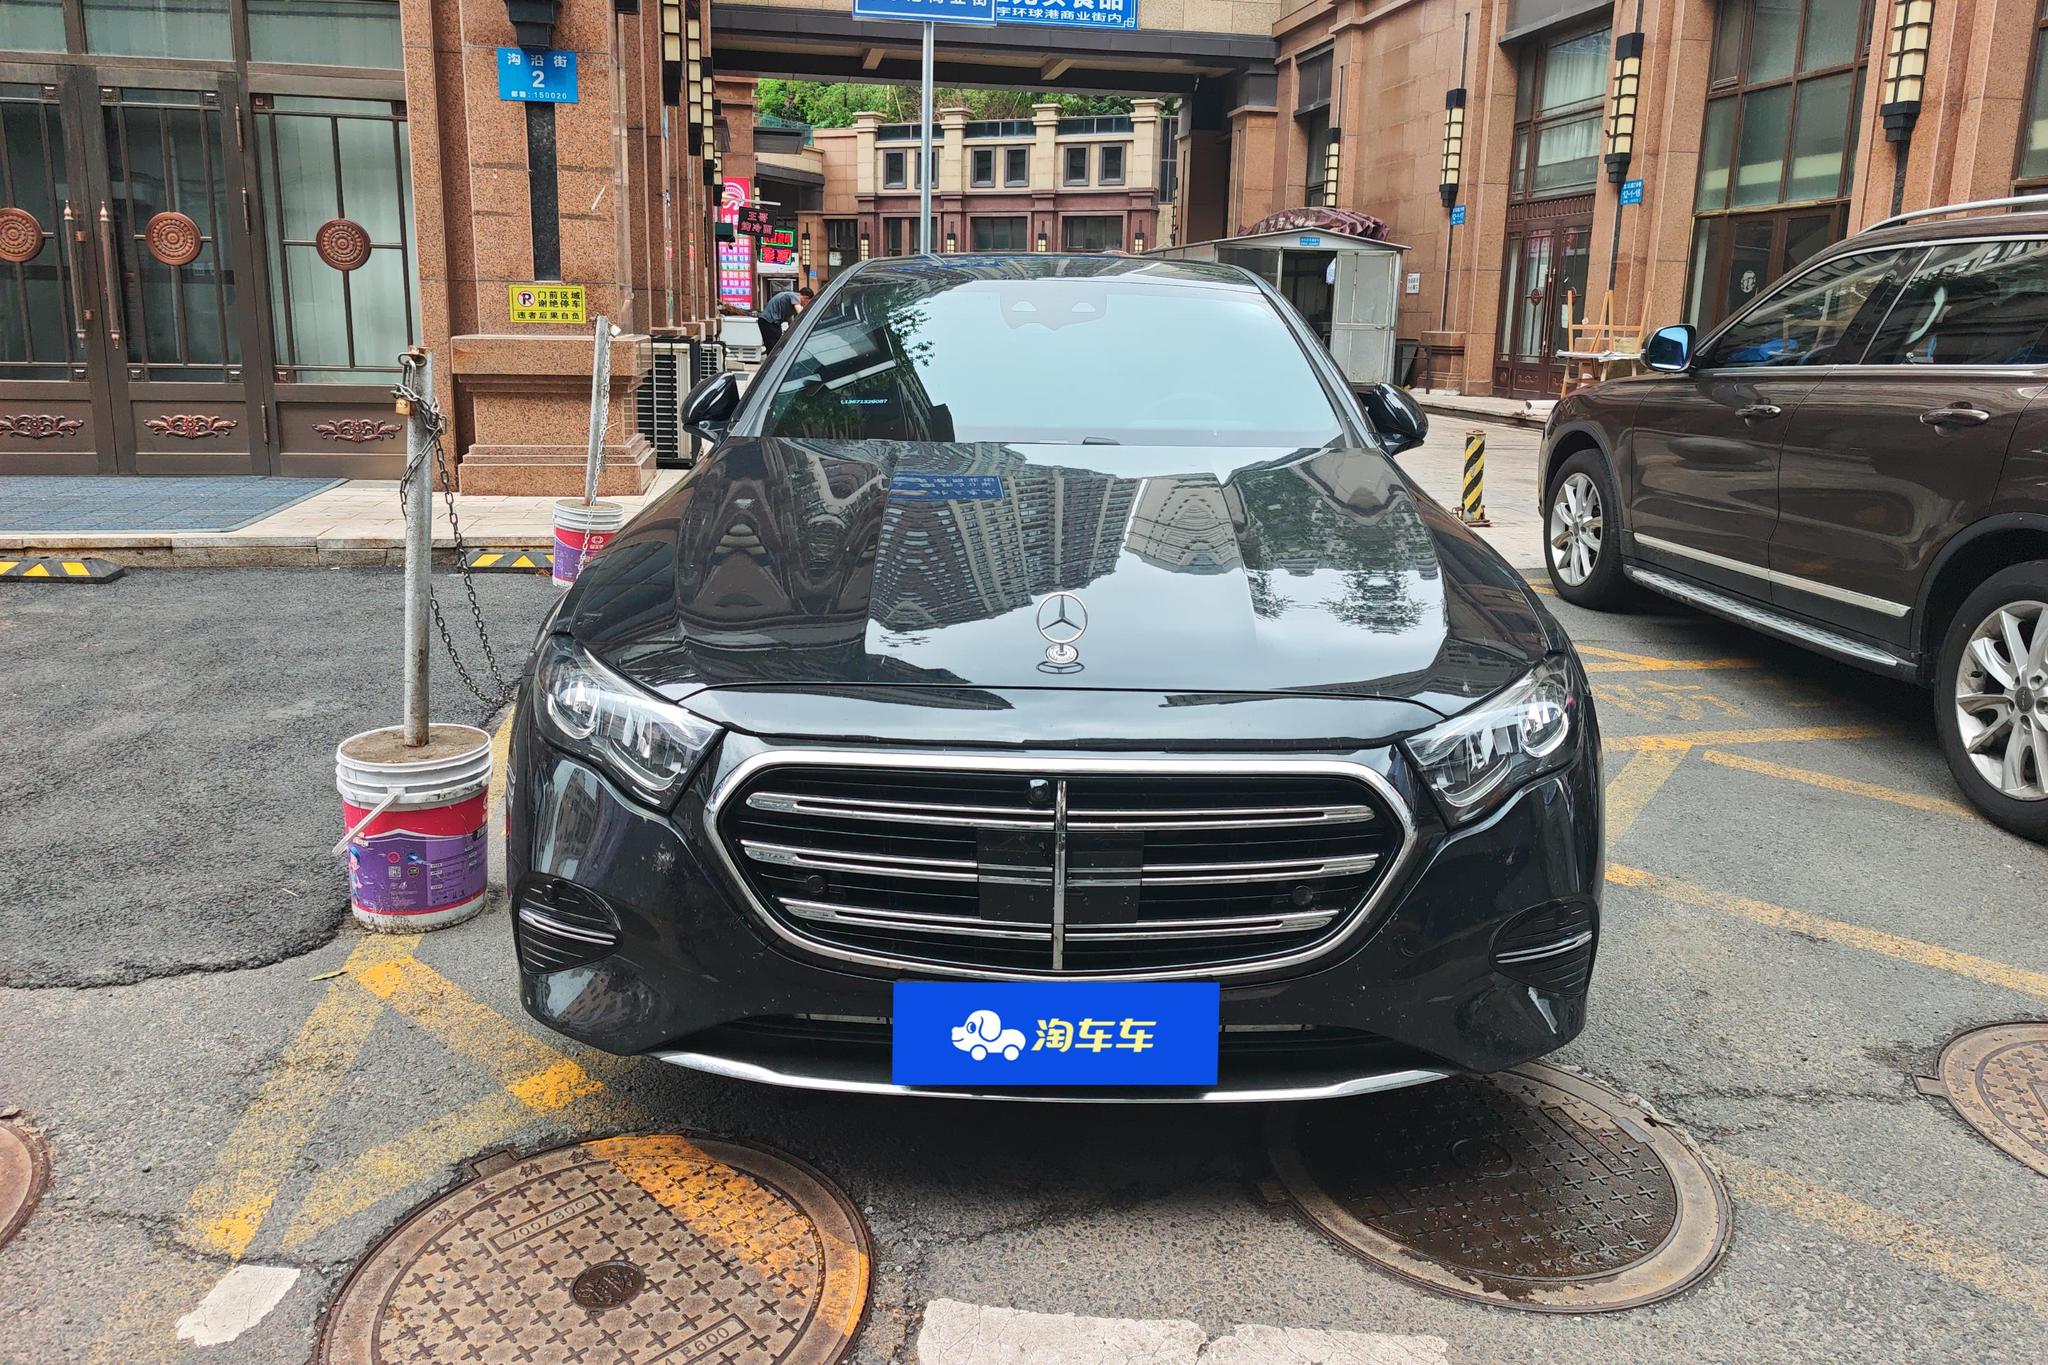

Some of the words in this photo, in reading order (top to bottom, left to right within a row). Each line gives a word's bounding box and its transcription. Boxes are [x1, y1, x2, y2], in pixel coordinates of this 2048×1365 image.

[507, 52, 568, 68] 沟沿街
[532, 70, 545, 88] 2
[538, 291, 580, 300] 门前区域
[538, 300, 580, 309] 谢绝停车
[517, 312, 579, 320] 违者后果自负
[511, 1201, 587, 1241] 700/800
